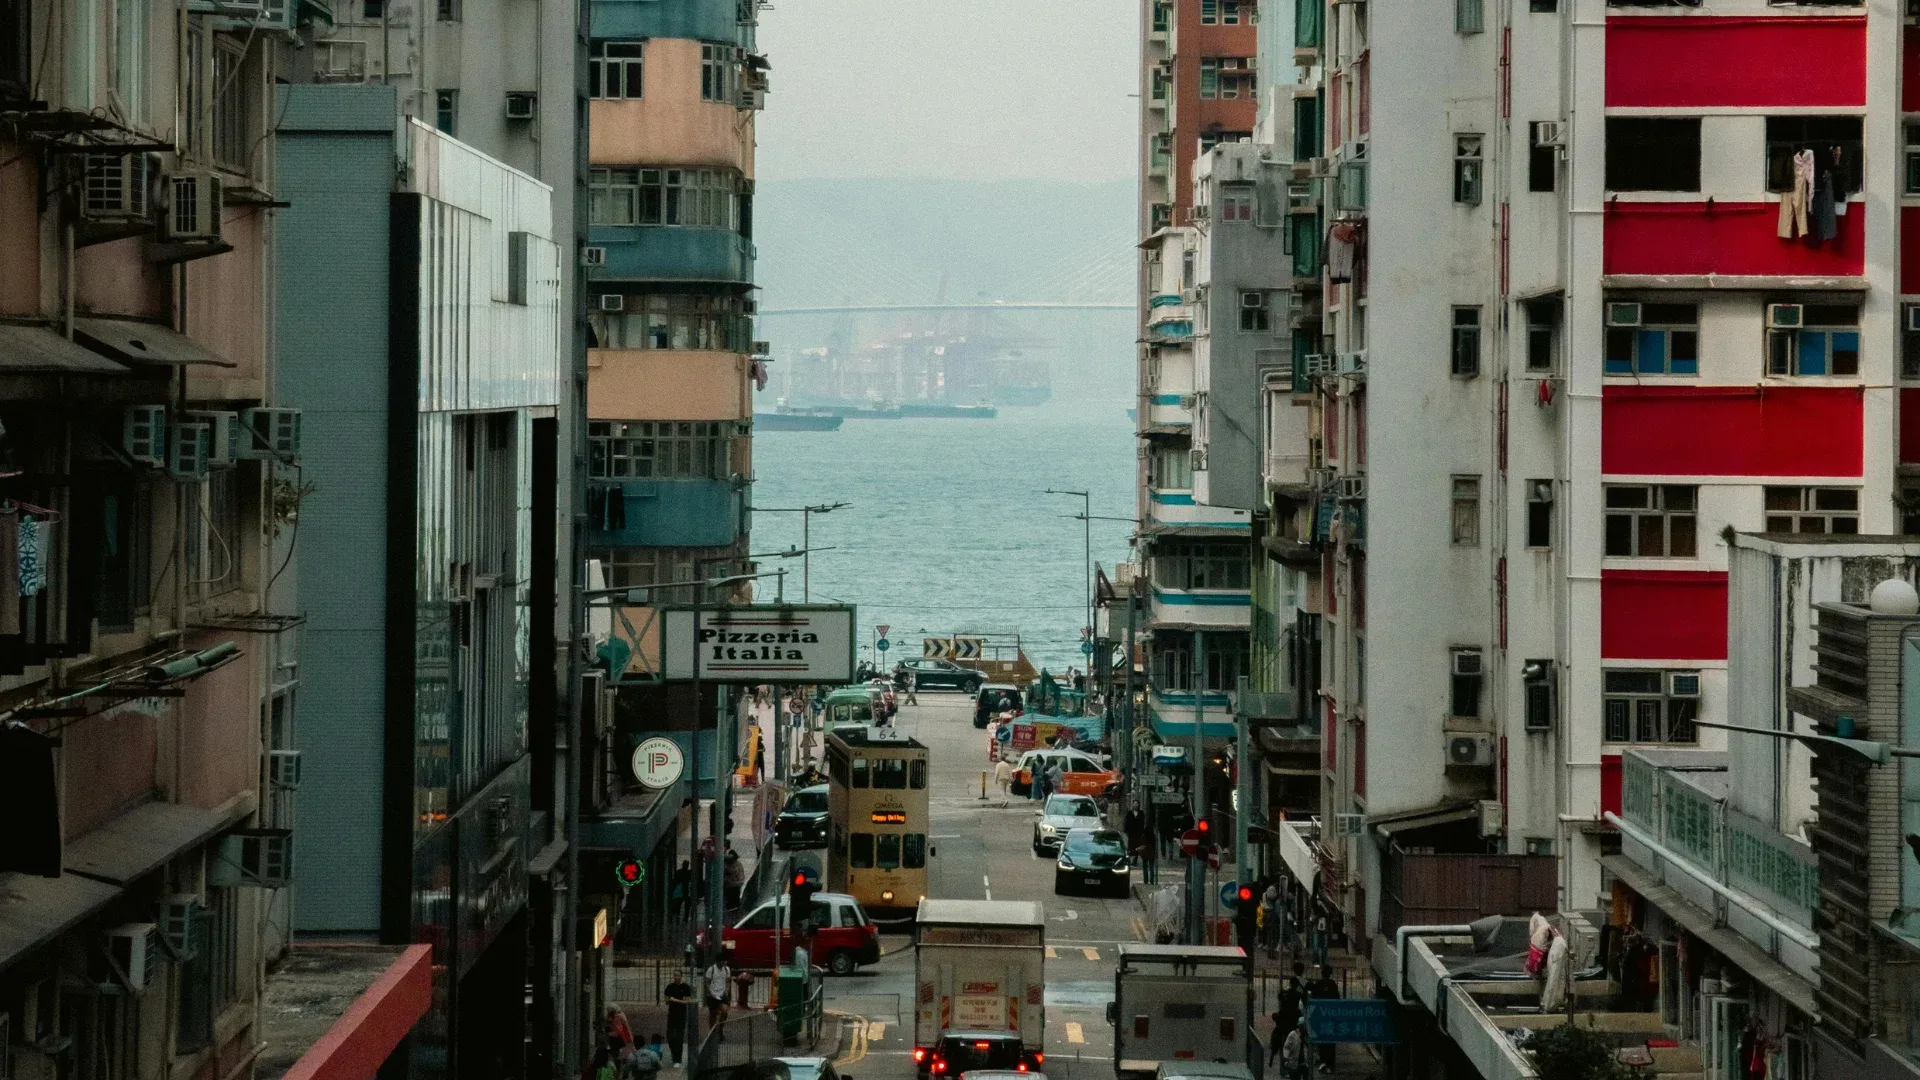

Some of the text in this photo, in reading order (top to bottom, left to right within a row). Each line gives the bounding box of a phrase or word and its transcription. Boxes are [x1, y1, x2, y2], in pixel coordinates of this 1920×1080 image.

[699, 628, 818, 644] Pizzeria
[713, 646, 804, 660] Italia
[879, 730, 898, 740] 64
[1319, 1006, 1363, 1017] Victoria
